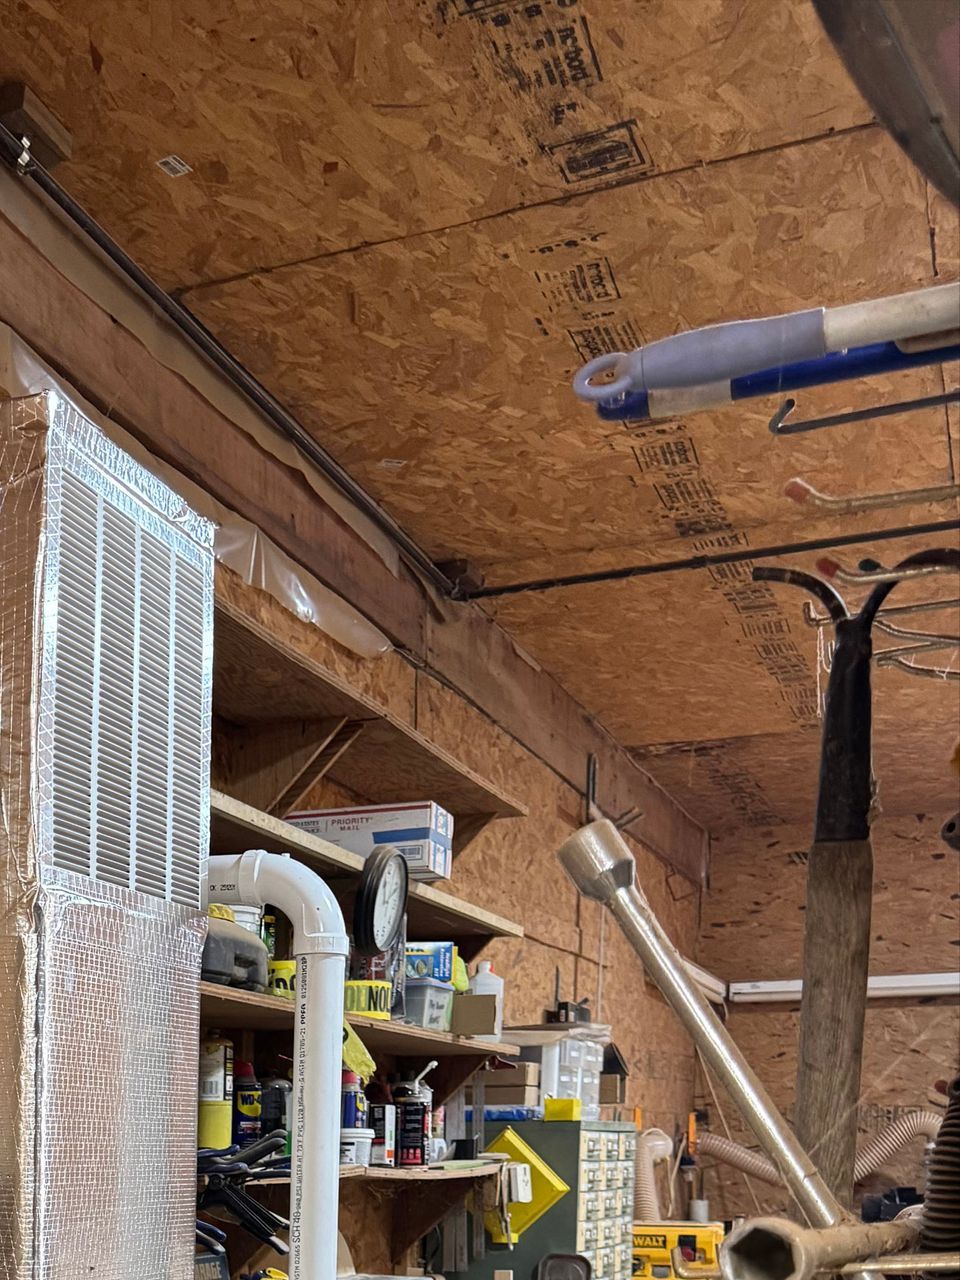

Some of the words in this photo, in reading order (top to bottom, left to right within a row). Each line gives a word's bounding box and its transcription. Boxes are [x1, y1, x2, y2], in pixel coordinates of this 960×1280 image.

[330, 817, 371, 826] PRIORITY
[339, 821, 360, 831] MAIL
[292, 1225, 301, 1244] SCH
[633, 1235, 665, 1247] WALT
